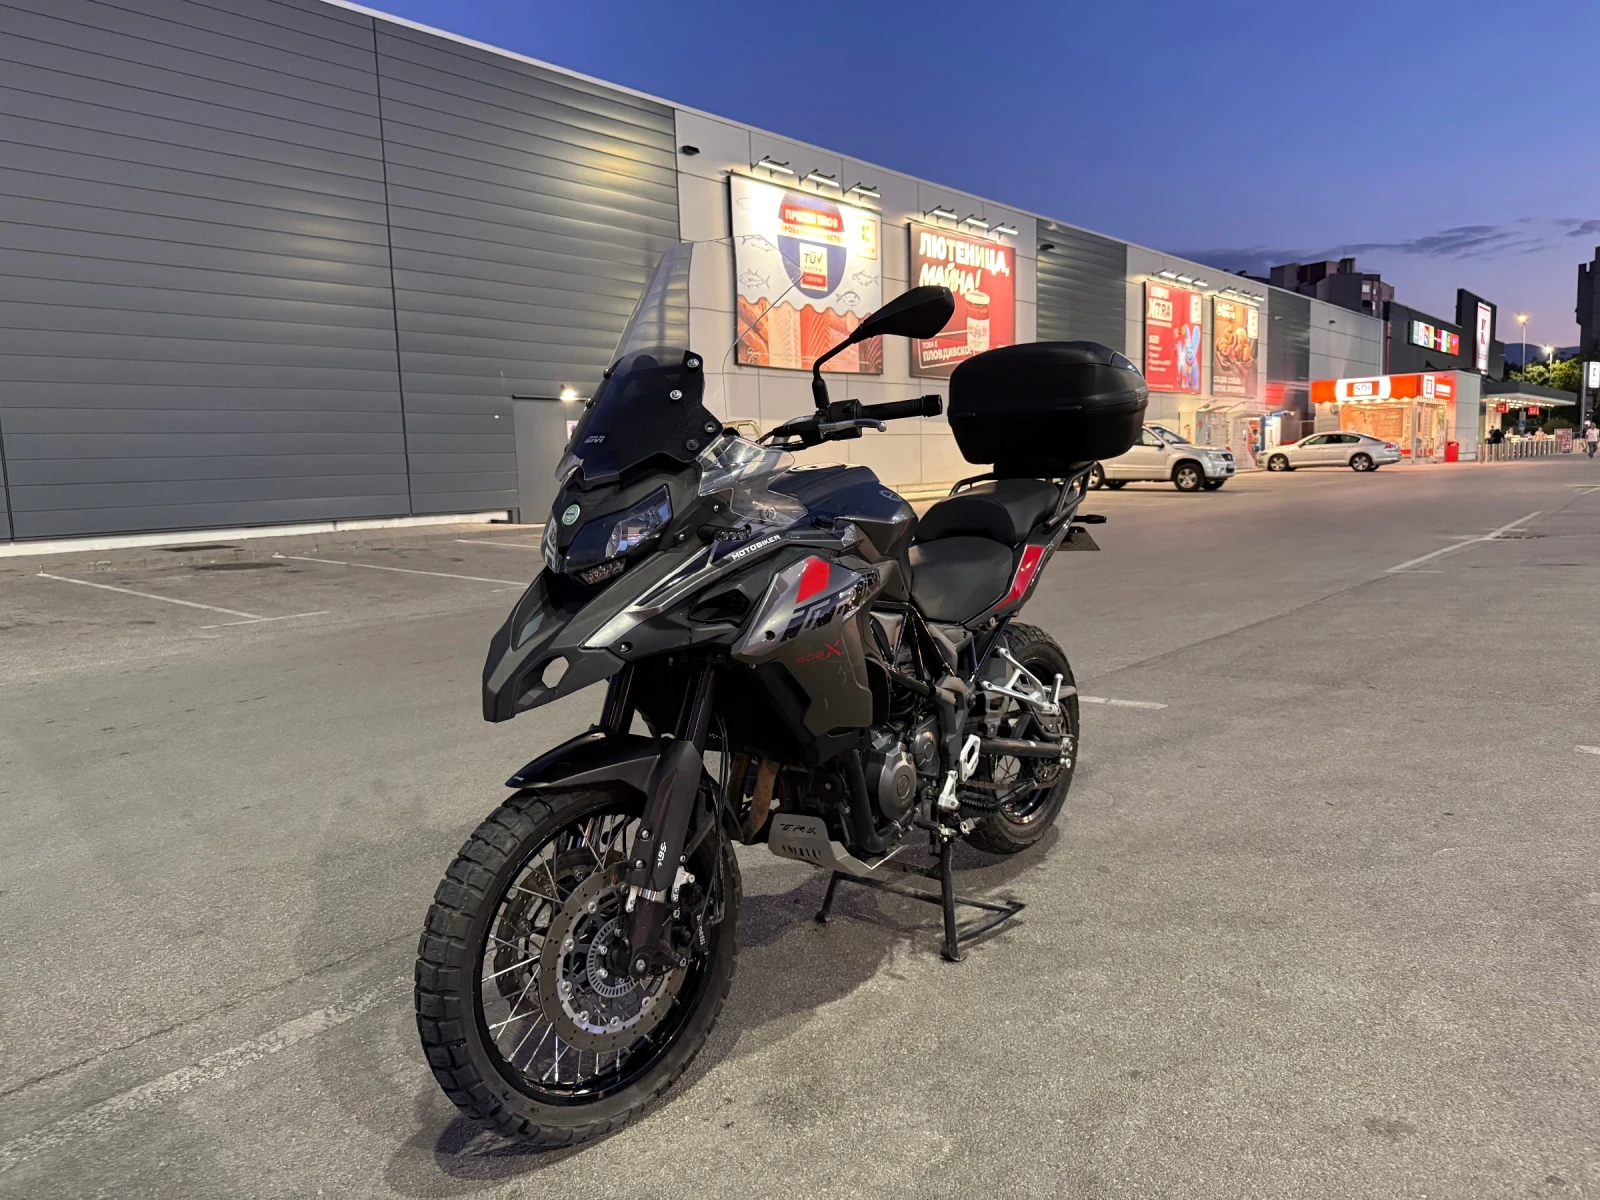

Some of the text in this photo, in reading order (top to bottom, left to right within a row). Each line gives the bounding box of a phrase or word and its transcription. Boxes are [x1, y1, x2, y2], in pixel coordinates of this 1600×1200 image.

[919, 232, 1010, 277] ЛЮТЕНИЦА,
[918, 262, 982, 296] МАЙНА!
[731, 534, 782, 560] MOTOBIKER
